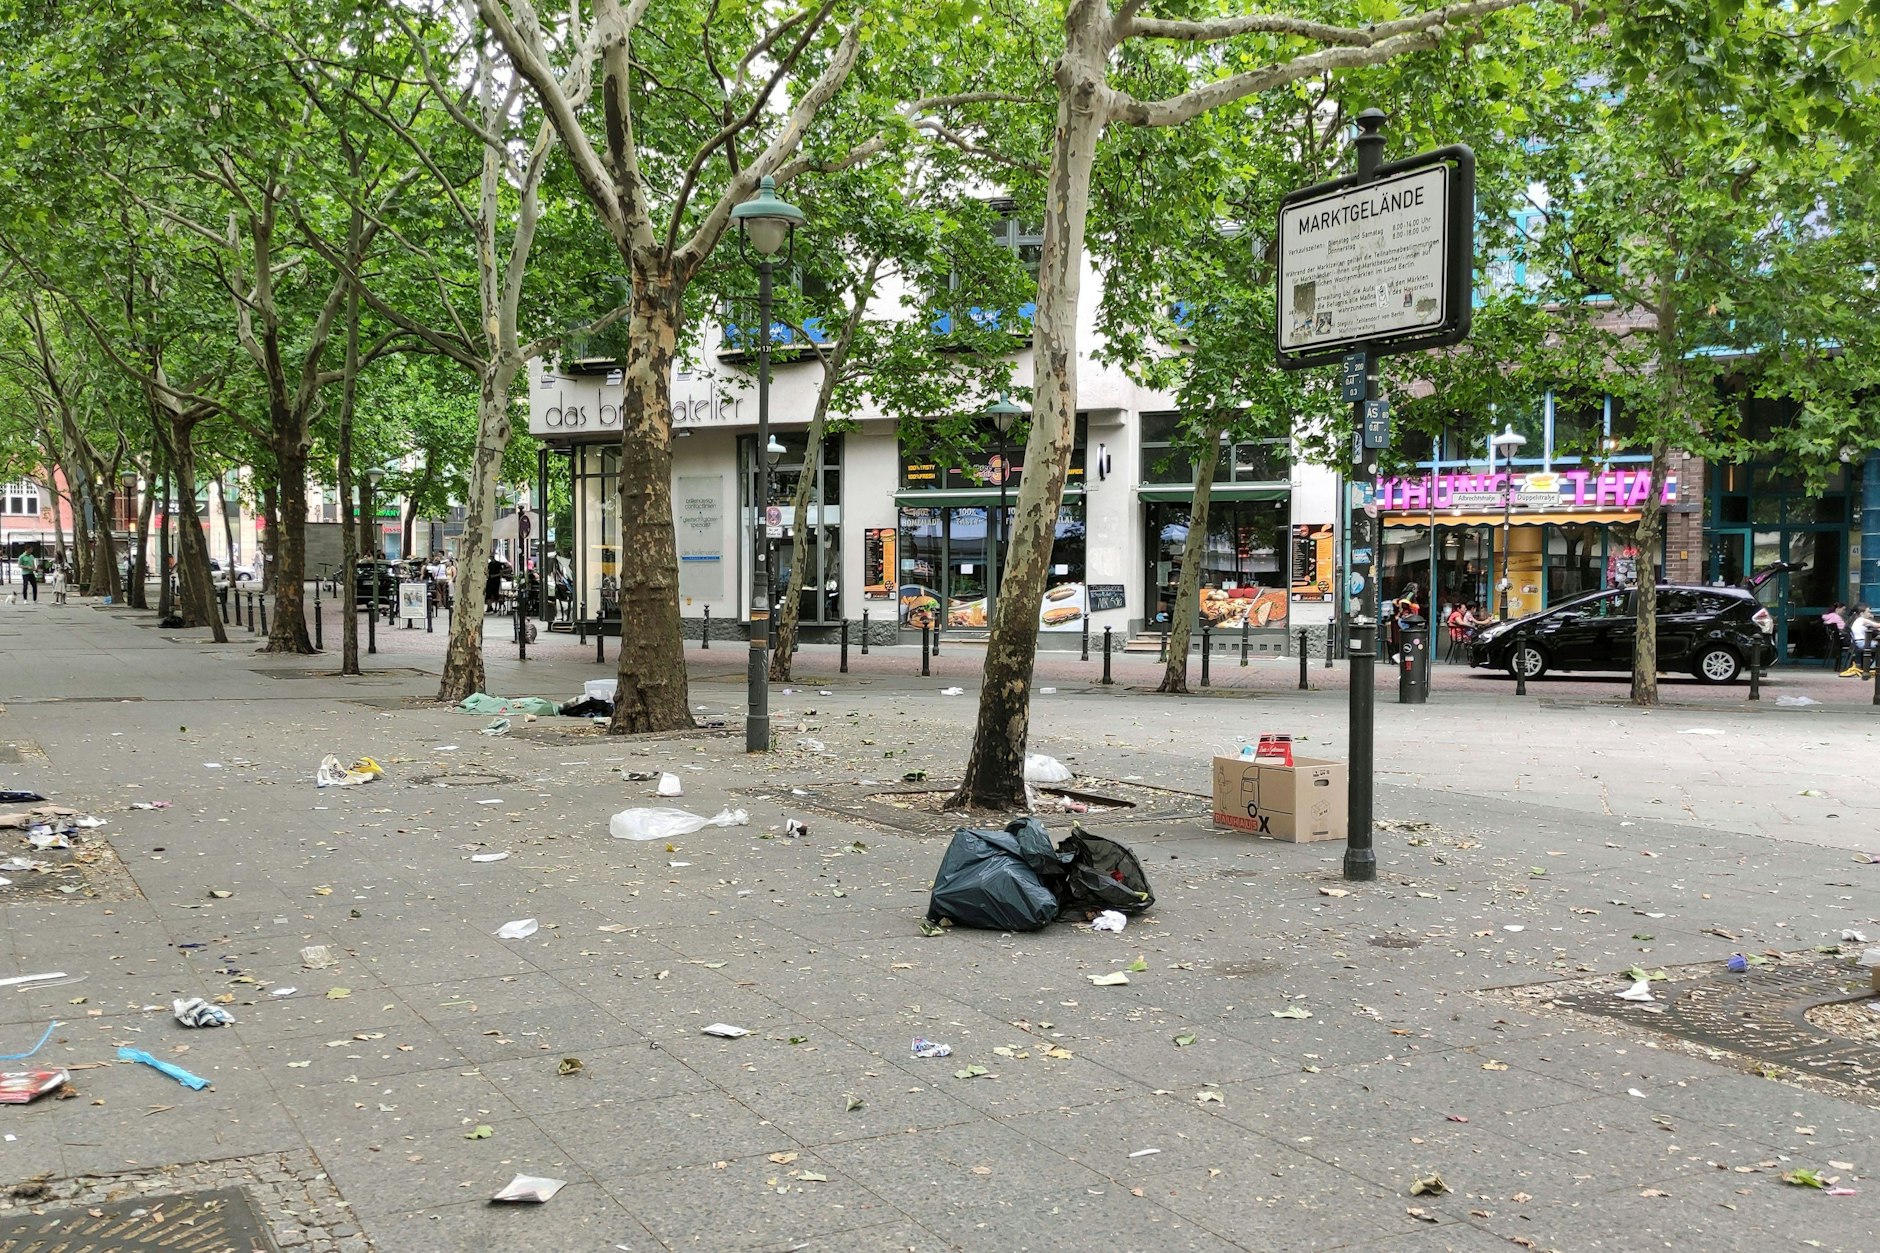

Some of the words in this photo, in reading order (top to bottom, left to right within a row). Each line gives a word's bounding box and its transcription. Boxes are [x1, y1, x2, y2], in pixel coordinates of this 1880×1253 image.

[1299, 186, 1423, 235] MARKTGELÄNDE
[1328, 237, 1348, 246] Dienstag
[1361, 228, 1383, 238] Samstag
[1328, 243, 1355, 254] Donnerstag
[1374, 239, 1439, 258] Teilnahmebestimmungen
[1384, 264, 1396, 272] Land
[1398, 261, 1414, 269] Berlin
[1344, 362, 1349, 372] S
[1354, 363, 1364, 371] 200
[546, 391, 586, 428] das
[1366, 408, 1378, 418] AS
[1517, 493, 1555, 502] Düppelstraße
[1215, 813, 1258, 830] BAUHAUS
